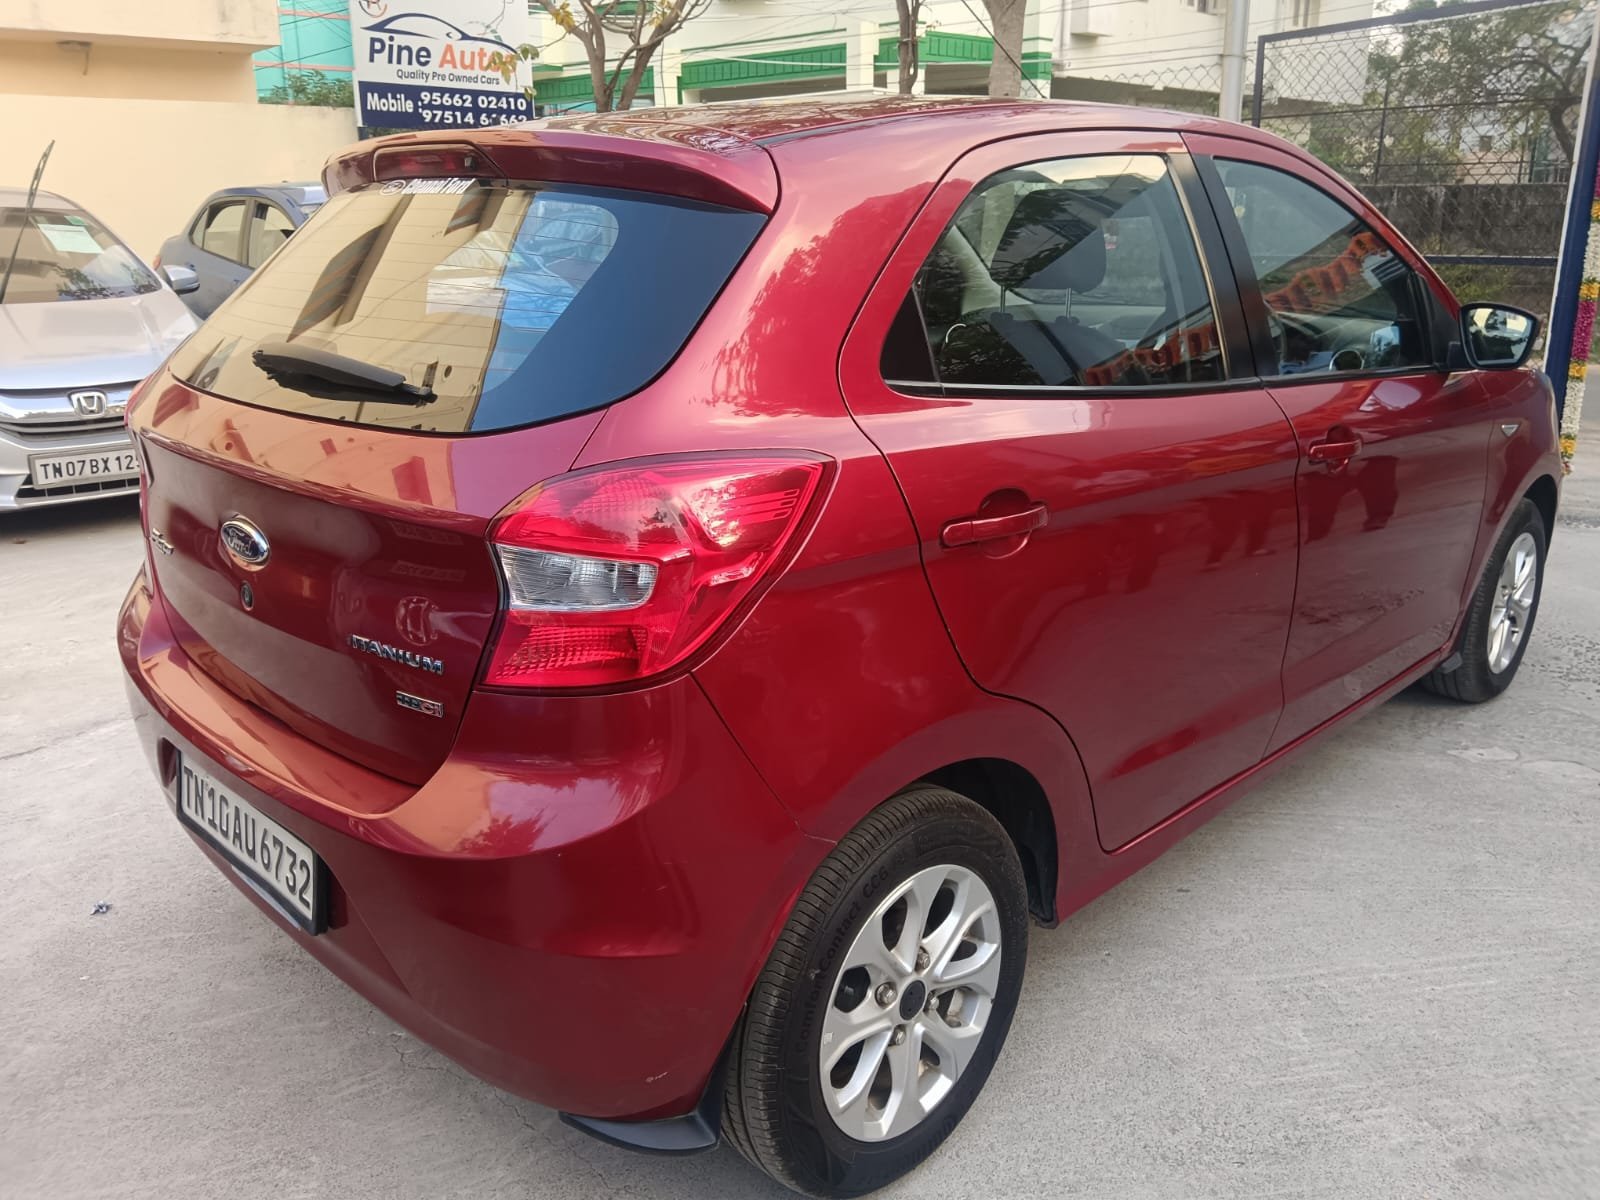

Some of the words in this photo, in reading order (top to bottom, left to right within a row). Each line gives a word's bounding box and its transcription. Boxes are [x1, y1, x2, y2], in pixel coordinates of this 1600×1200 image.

[369, 36, 431, 67] Pine
[396, 68, 430, 83] Quality
[432, 71, 446, 82] Pre
[449, 72, 479, 84] Owned
[480, 74, 500, 86] Cars
[366, 92, 414, 113] Mobile
[420, 92, 473, 108] 95662
[477, 95, 527, 111] 02410
[422, 110, 475, 126] 97514
[440, 178, 476, 194] Ford
[40, 455, 140, 480] TN07BX12
[228, 528, 254, 557] Ford
